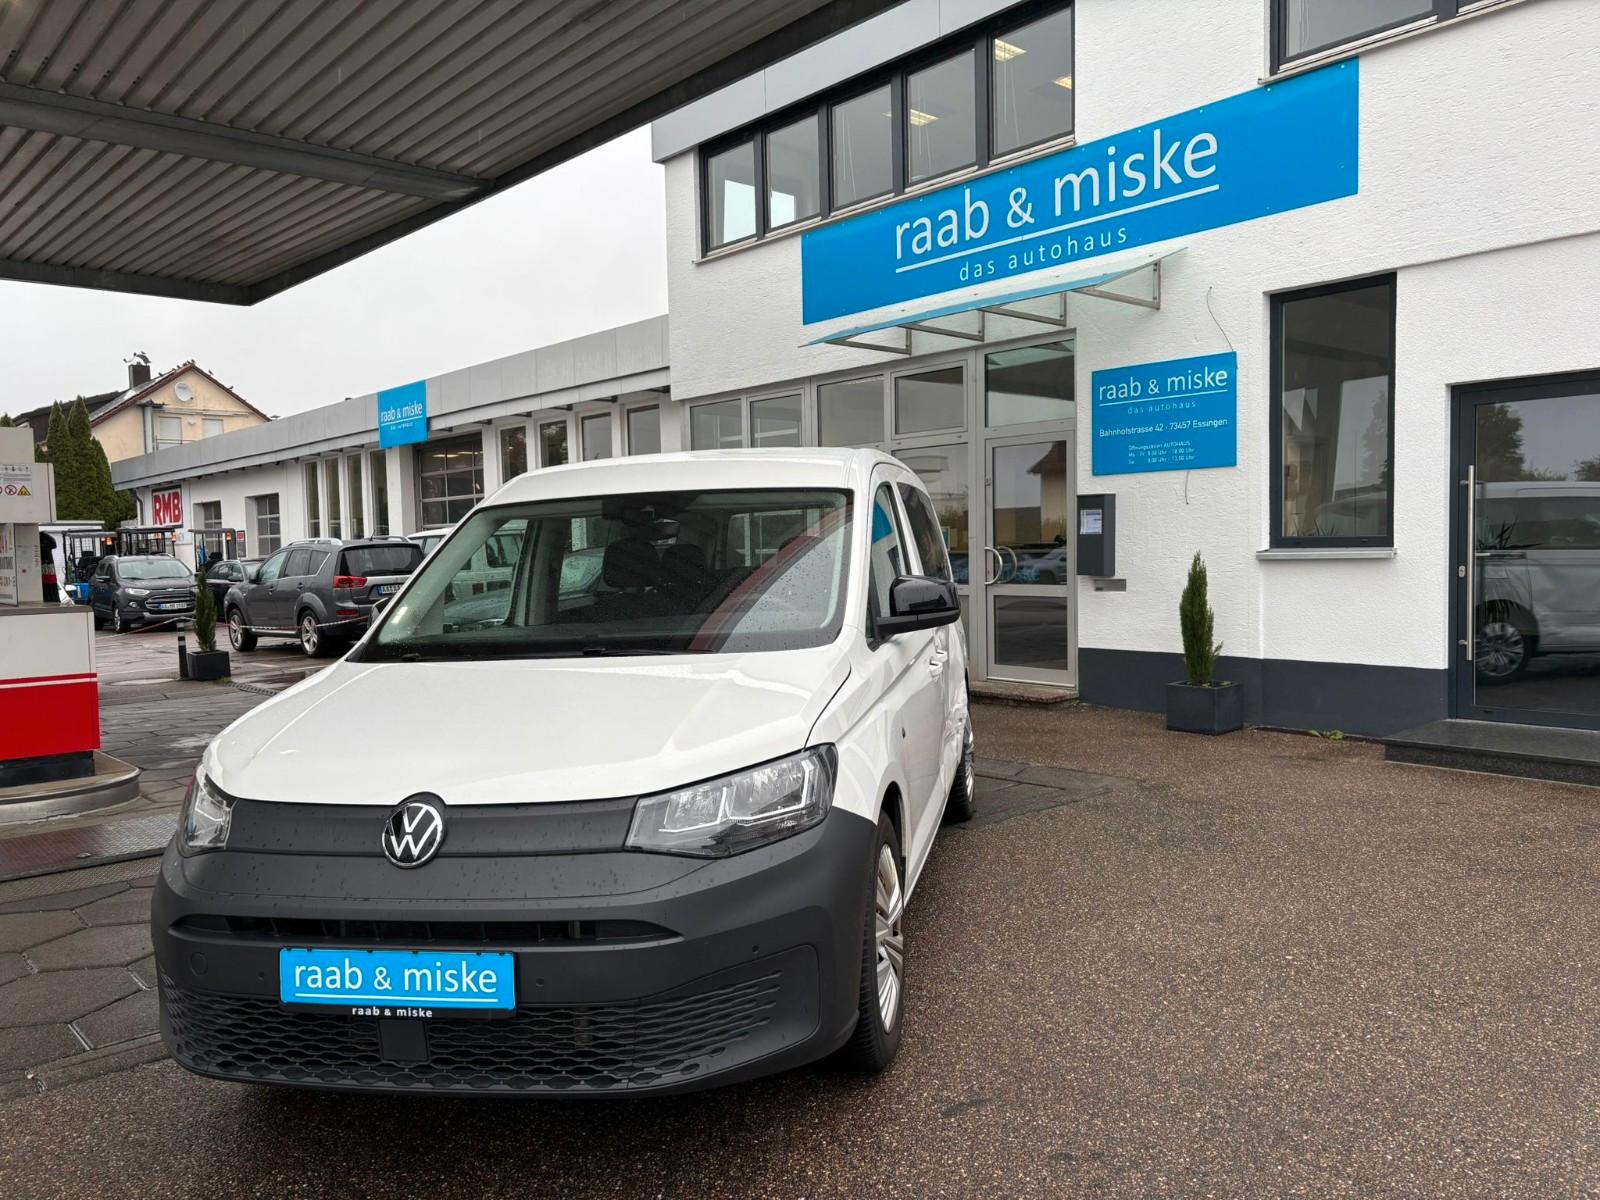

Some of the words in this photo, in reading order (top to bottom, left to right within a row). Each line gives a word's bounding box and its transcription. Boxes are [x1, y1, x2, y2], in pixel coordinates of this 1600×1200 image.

[895, 184, 990, 260] raab
[1006, 187, 1035, 230] &
[1054, 129, 1218, 218] miske
[959, 260, 996, 282] das
[1008, 227, 1128, 270] autohaus
[1099, 376, 1142, 401] raab
[1148, 379, 1160, 395] &
[1167, 366, 1228, 392] miske
[380, 406, 395, 421] raab
[397, 408, 401, 419] &
[402, 401, 422, 417] miske
[1127, 405, 1144, 415] das
[1148, 401, 1196, 413] autohaus
[1155, 423, 1164, 432] 42
[1170, 420, 1191, 431] 73457
[1192, 418, 1228, 430] Essingen
[153, 490, 182, 525] RMB
[383, 803, 442, 866] VW
[294, 957, 363, 990] raab
[373, 966, 392, 991] &
[403, 960, 498, 993] miske
[352, 1005, 380, 1017] raab
[384, 1007, 392, 1017] &
[396, 1006, 433, 1018] miske
